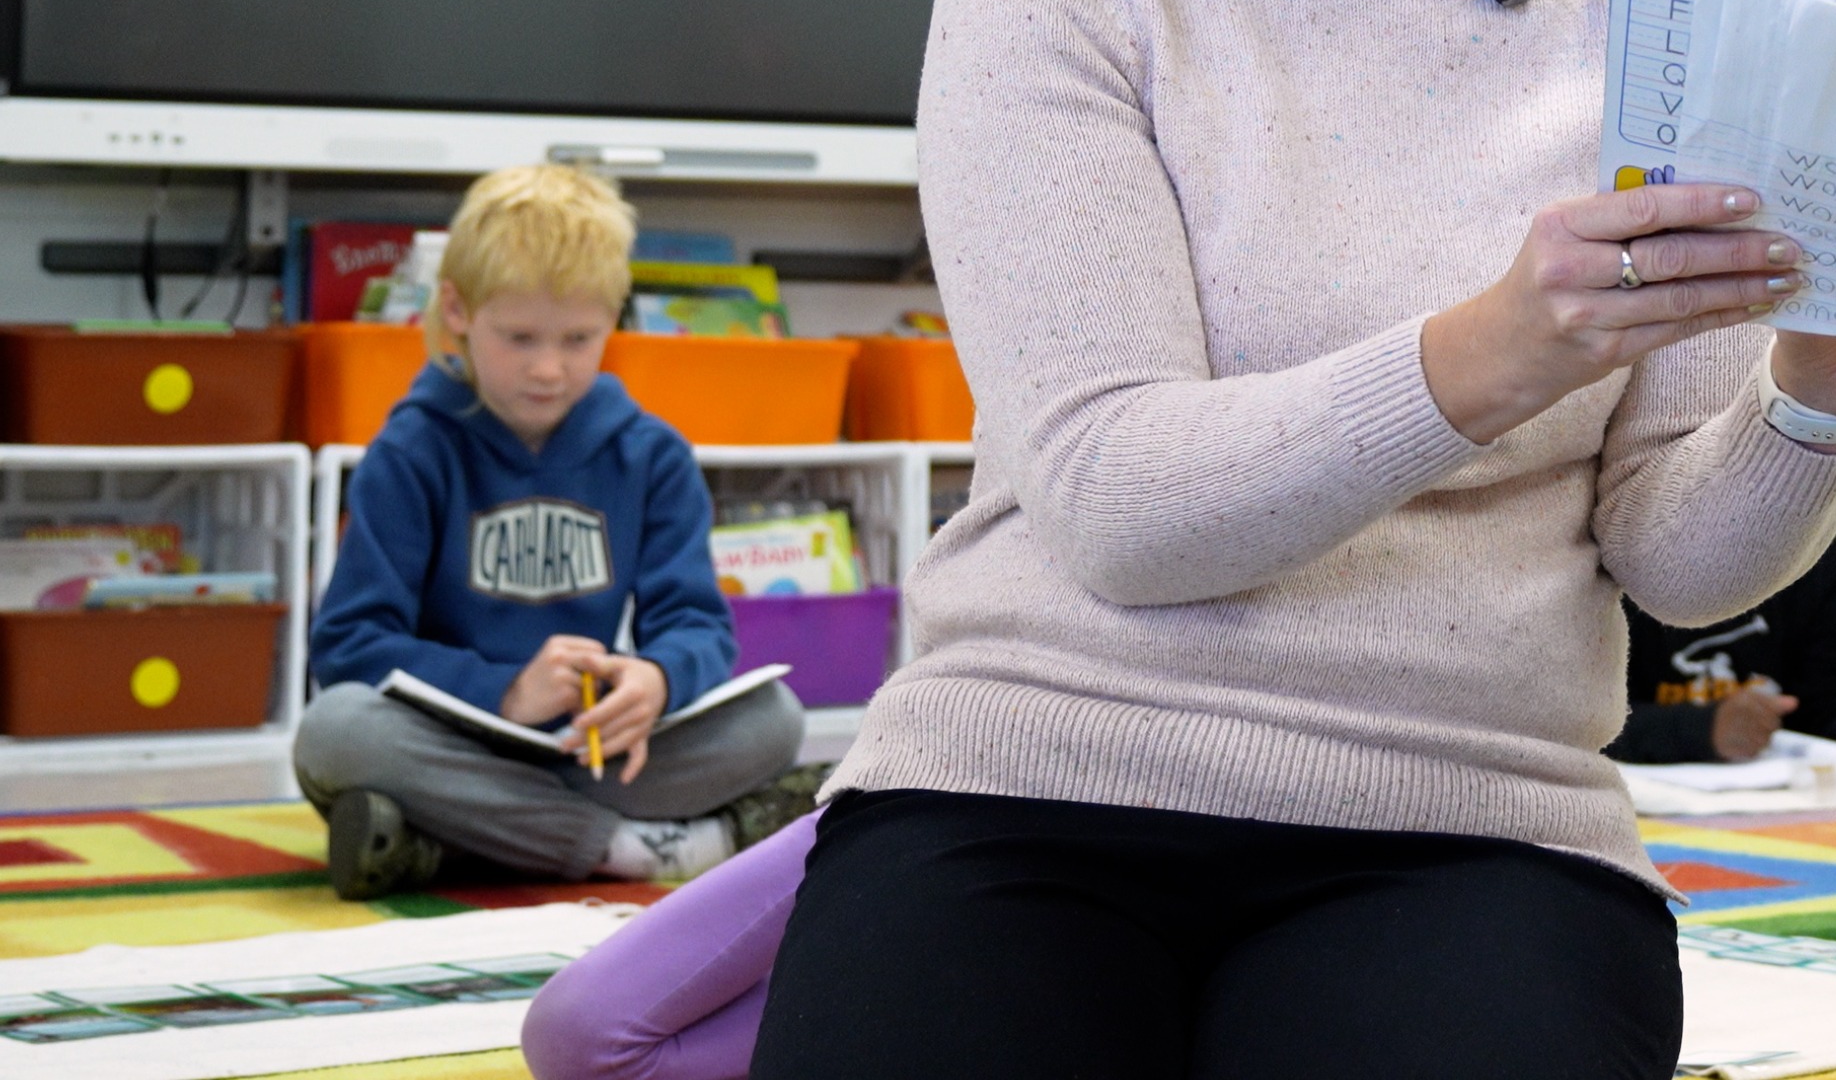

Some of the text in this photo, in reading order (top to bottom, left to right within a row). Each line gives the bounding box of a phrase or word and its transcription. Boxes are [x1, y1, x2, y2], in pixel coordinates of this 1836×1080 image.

[1666, 29, 1685, 55] L
[1662, 62, 1687, 87] Q
[1660, 91, 1684, 116] V
